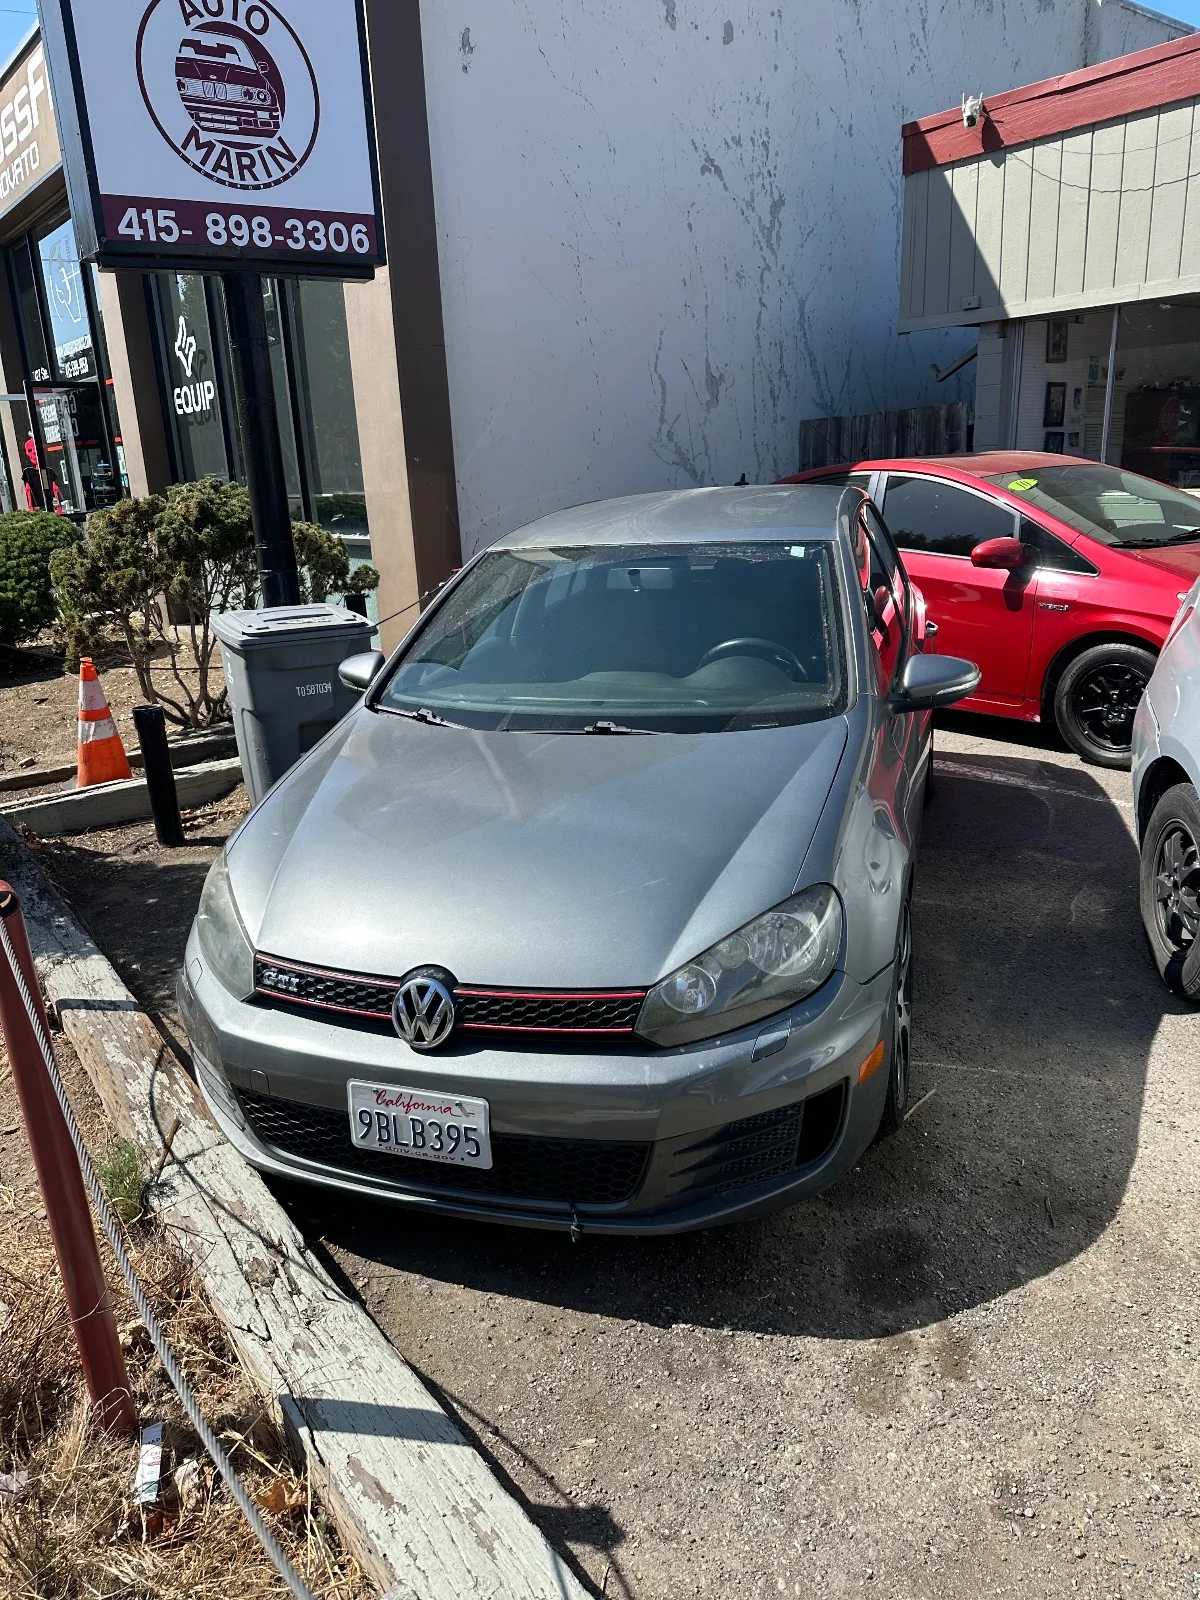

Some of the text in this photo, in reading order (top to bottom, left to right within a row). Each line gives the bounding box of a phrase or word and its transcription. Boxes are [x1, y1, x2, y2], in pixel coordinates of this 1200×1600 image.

[0, 45, 53, 165] SSF
[180, 125, 298, 181] MARIN
[117, 207, 370, 254] 415- 898-3306
[174, 380, 215, 415] EQUIP
[375, 1089, 463, 1117] California
[357, 1108, 481, 1158] 9BLB395
[385, 1144, 456, 1161] dmv.ca.gov
